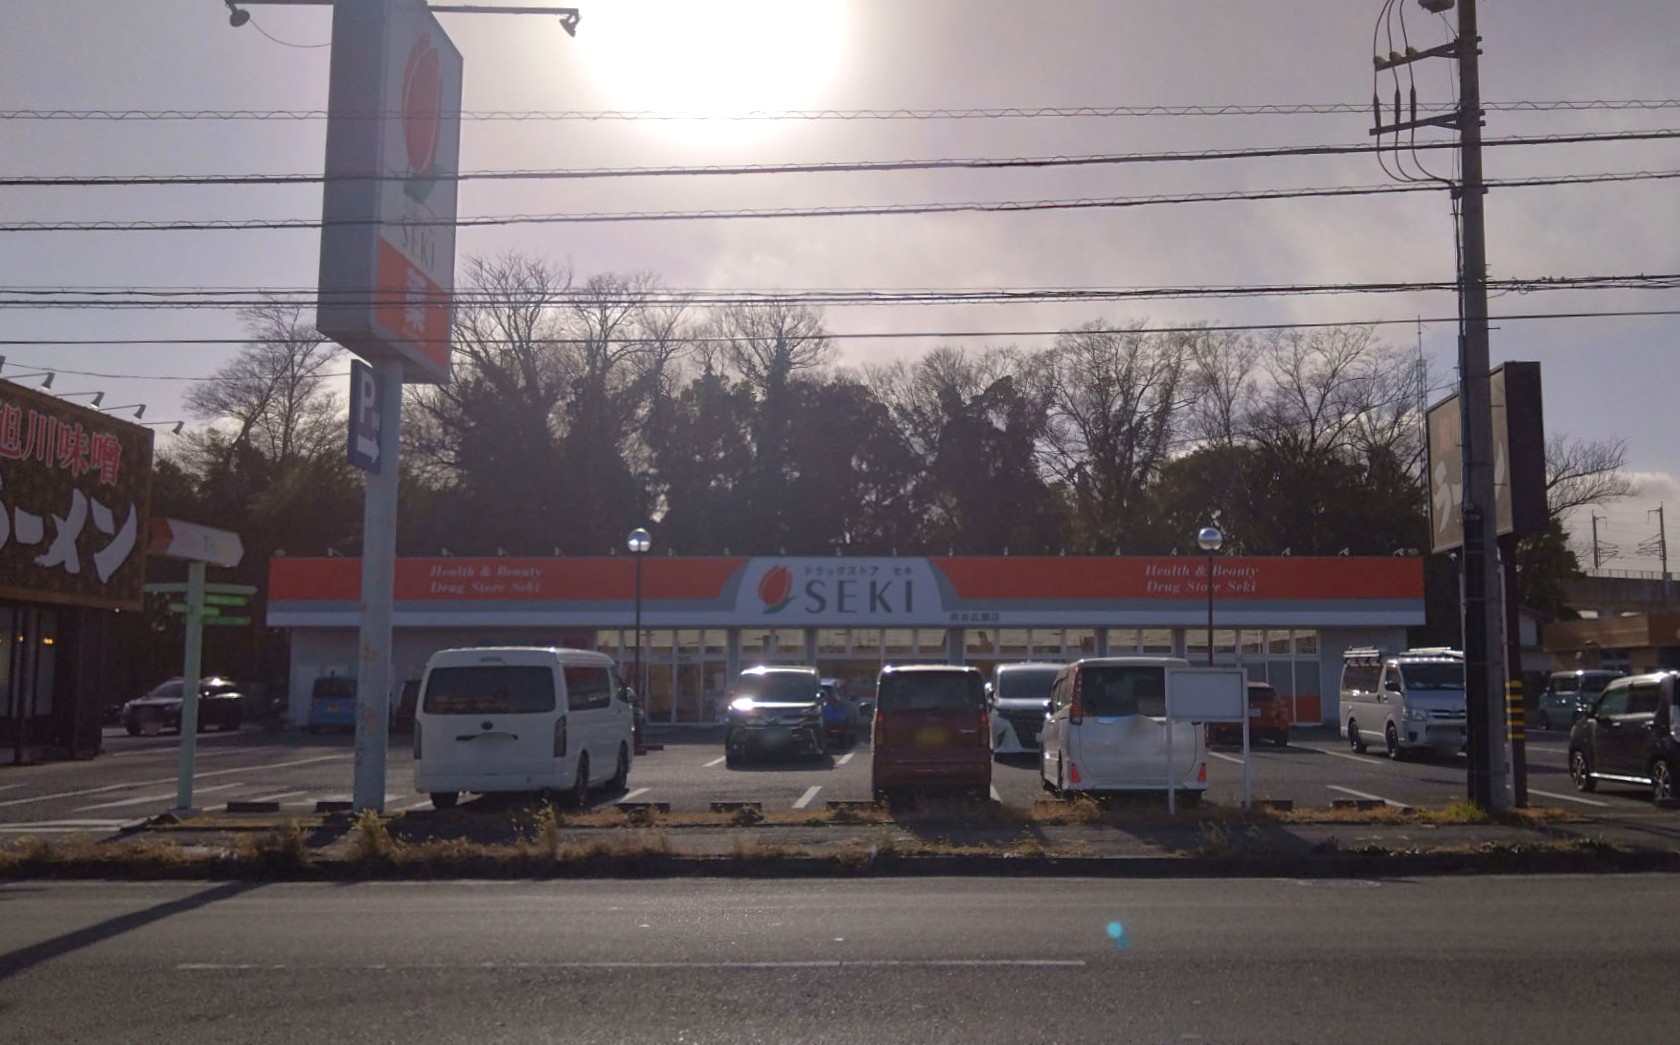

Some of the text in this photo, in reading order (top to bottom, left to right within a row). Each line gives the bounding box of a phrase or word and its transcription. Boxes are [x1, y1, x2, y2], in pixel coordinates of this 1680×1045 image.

[0, 472, 137, 584] ーメン
[430, 565, 544, 580] Health & Beauty
[805, 566, 880, 577] ドラッグストア
[1145, 565, 1259, 580] Health & Beauty
[430, 582, 465, 595] Drug
[1146, 581, 1181, 594] Drug
[1228, 581, 1256, 593] Seki
[805, 579, 913, 614] SEKI
